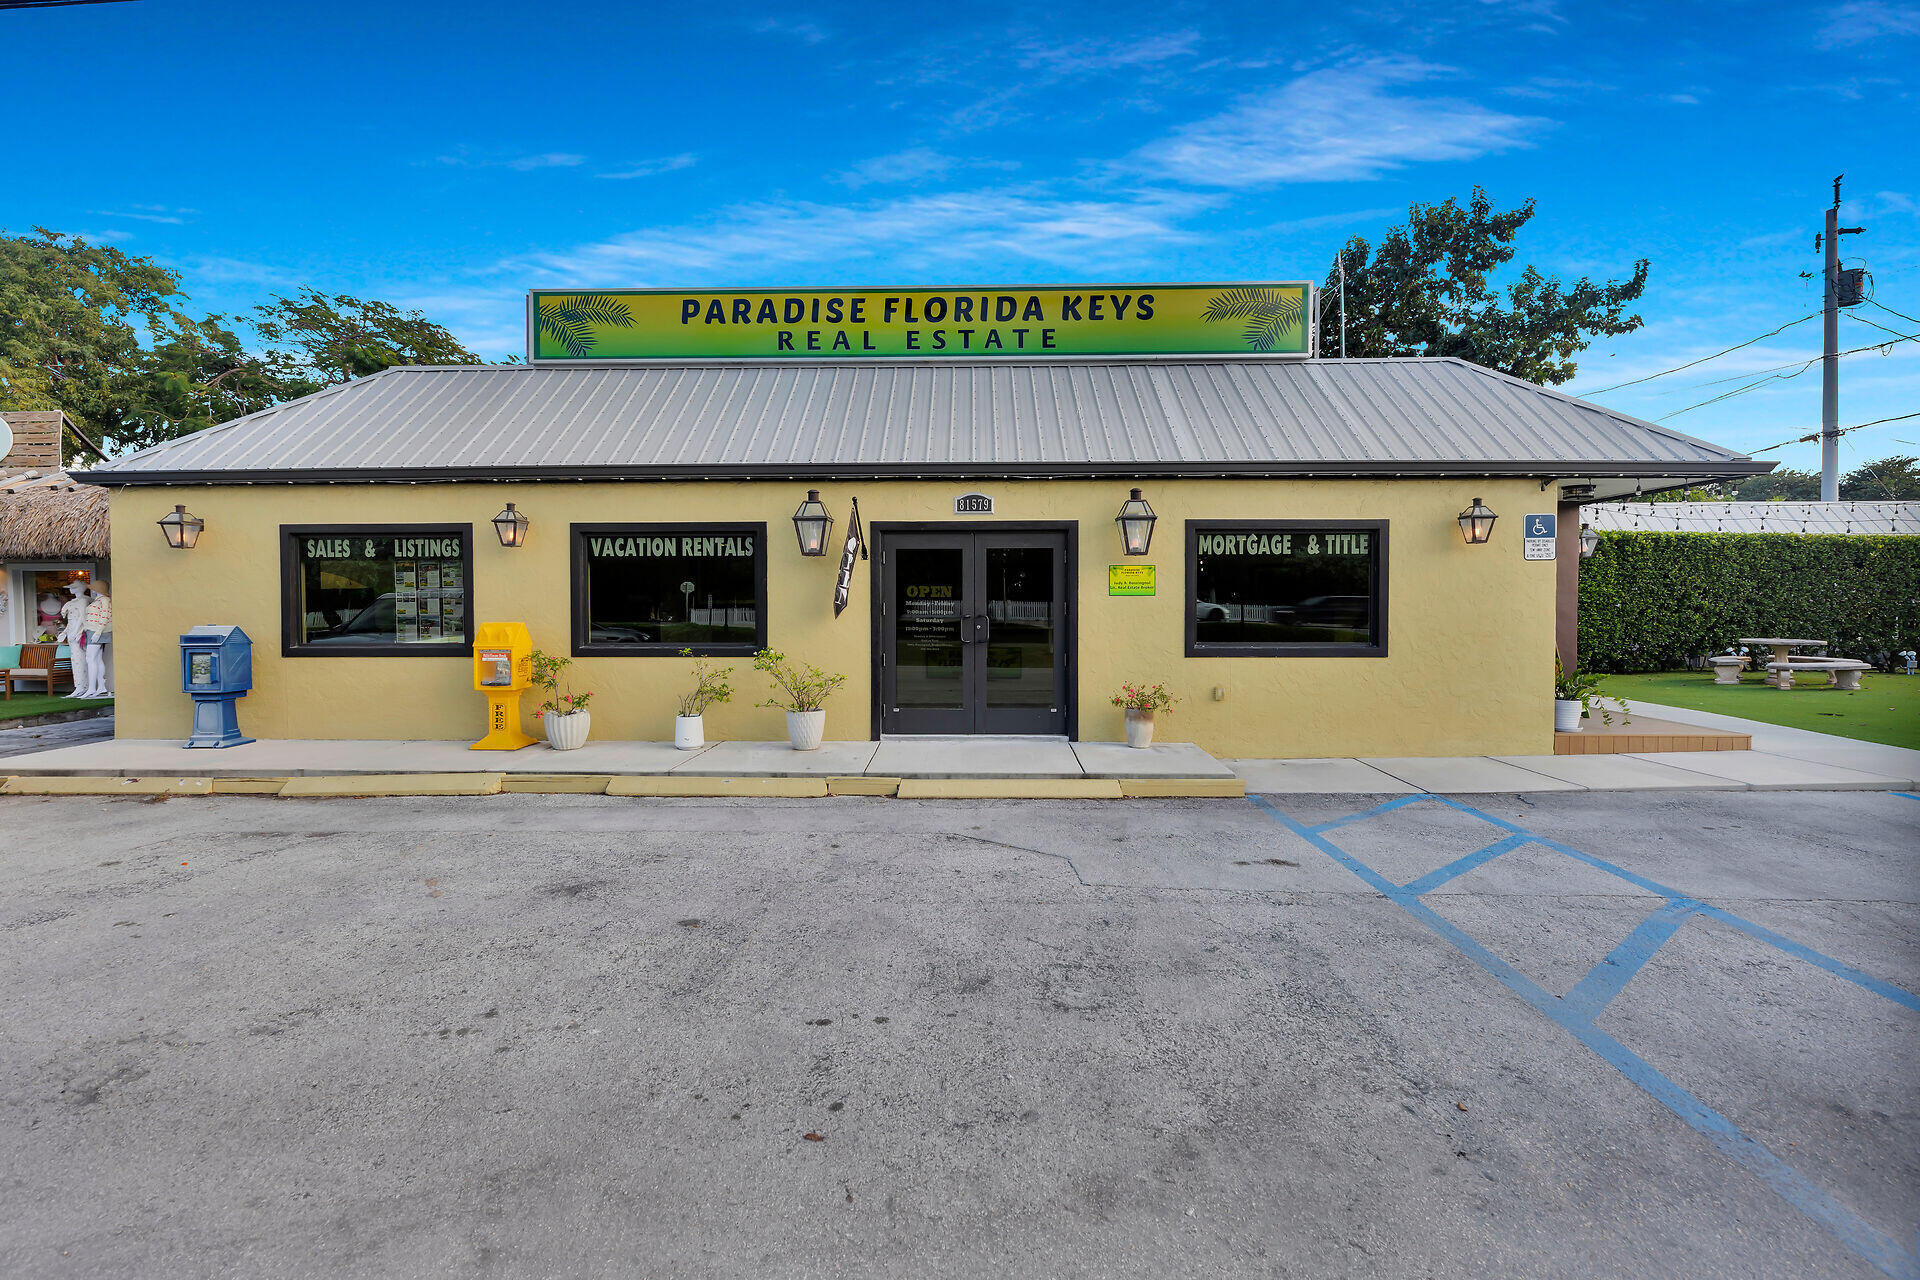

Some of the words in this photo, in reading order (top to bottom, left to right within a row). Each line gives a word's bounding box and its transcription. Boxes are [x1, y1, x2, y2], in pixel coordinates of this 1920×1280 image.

[681, 298, 866, 325] PARADISE
[883, 295, 1045, 323] FLORIDA
[1061, 294, 1155, 321] KEYS
[777, 330, 876, 351] REAL
[906, 328, 1057, 350] ESTATE
[959, 498, 989, 511] 81579
[307, 539, 351, 558] SALES
[364, 539, 376, 558] &
[394, 538, 460, 558] LISTINGS
[590, 537, 677, 557] VACATION
[682, 537, 754, 557] RENTALS
[1198, 534, 1292, 555] MORTGAGE
[1307, 534, 1320, 555] &
[1325, 534, 1369, 555] TITLE
[906, 585, 952, 598] OPEN
[494, 704, 504, 730] FREE
